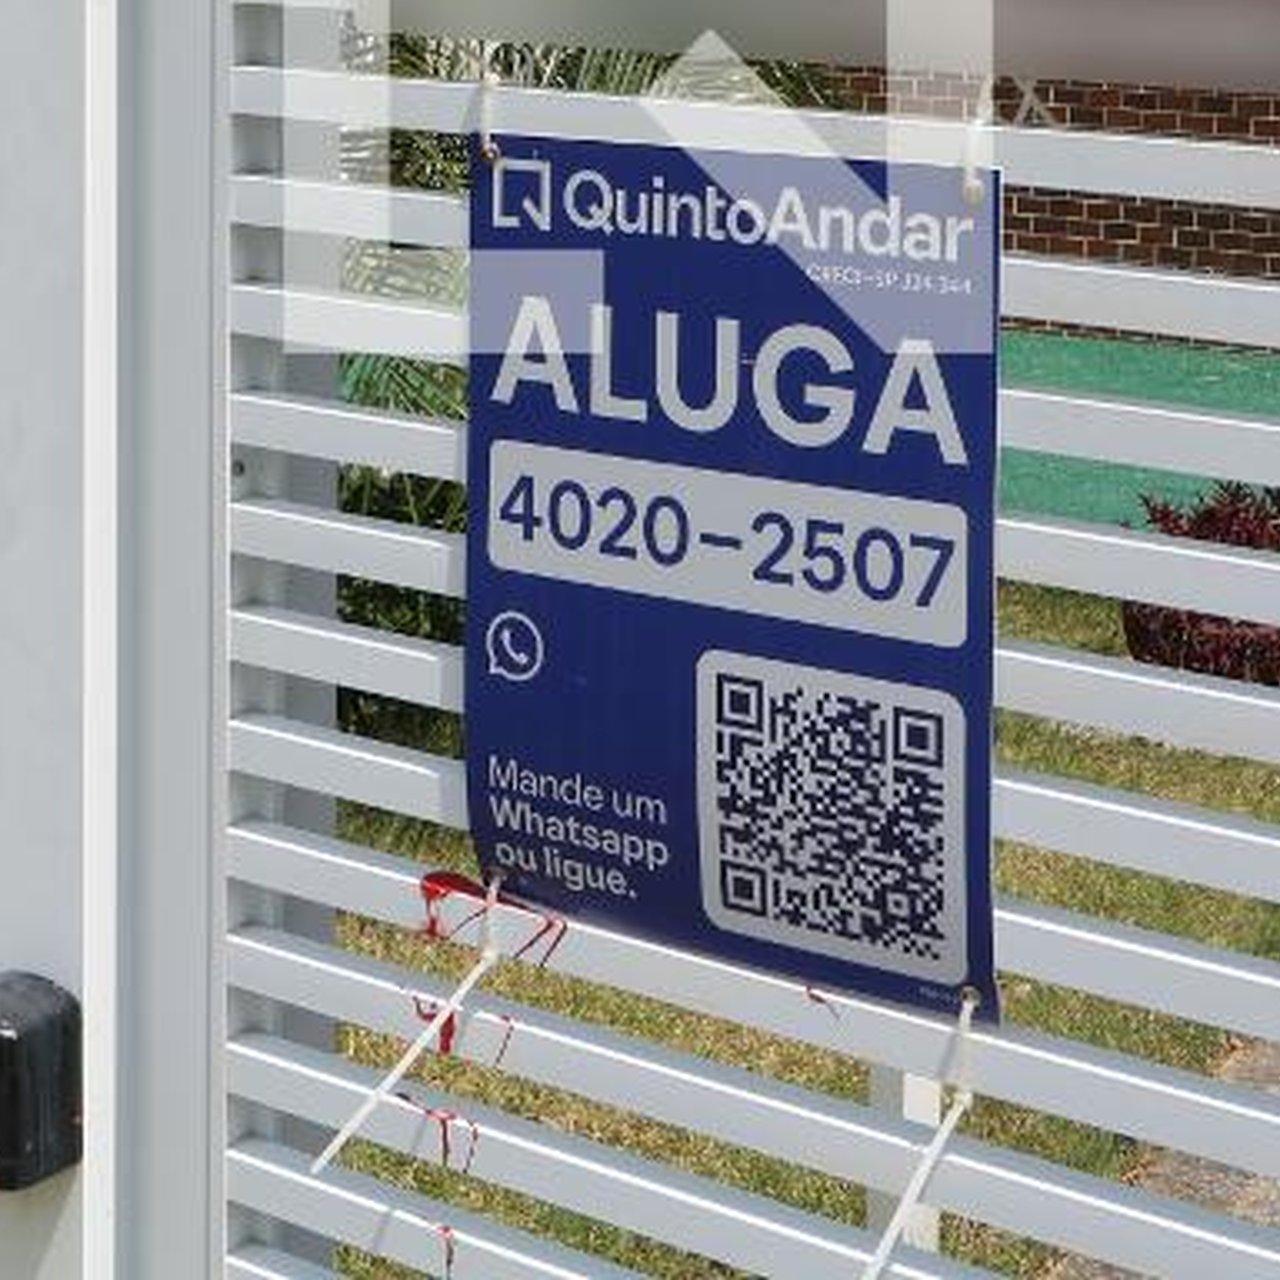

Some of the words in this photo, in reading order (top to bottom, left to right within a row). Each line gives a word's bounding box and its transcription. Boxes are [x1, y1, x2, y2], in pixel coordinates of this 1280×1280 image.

[562, 169, 975, 262] QuintoAndar
[489, 294, 970, 466] ALUGA
[498, 475, 955, 607] 4020-2507
[489, 755, 604, 811] Mande
[612, 789, 667, 824] um
[488, 795, 671, 871] Whatsapp
[496, 842, 538, 871] ou
[543, 846, 638, 898] ligue.
